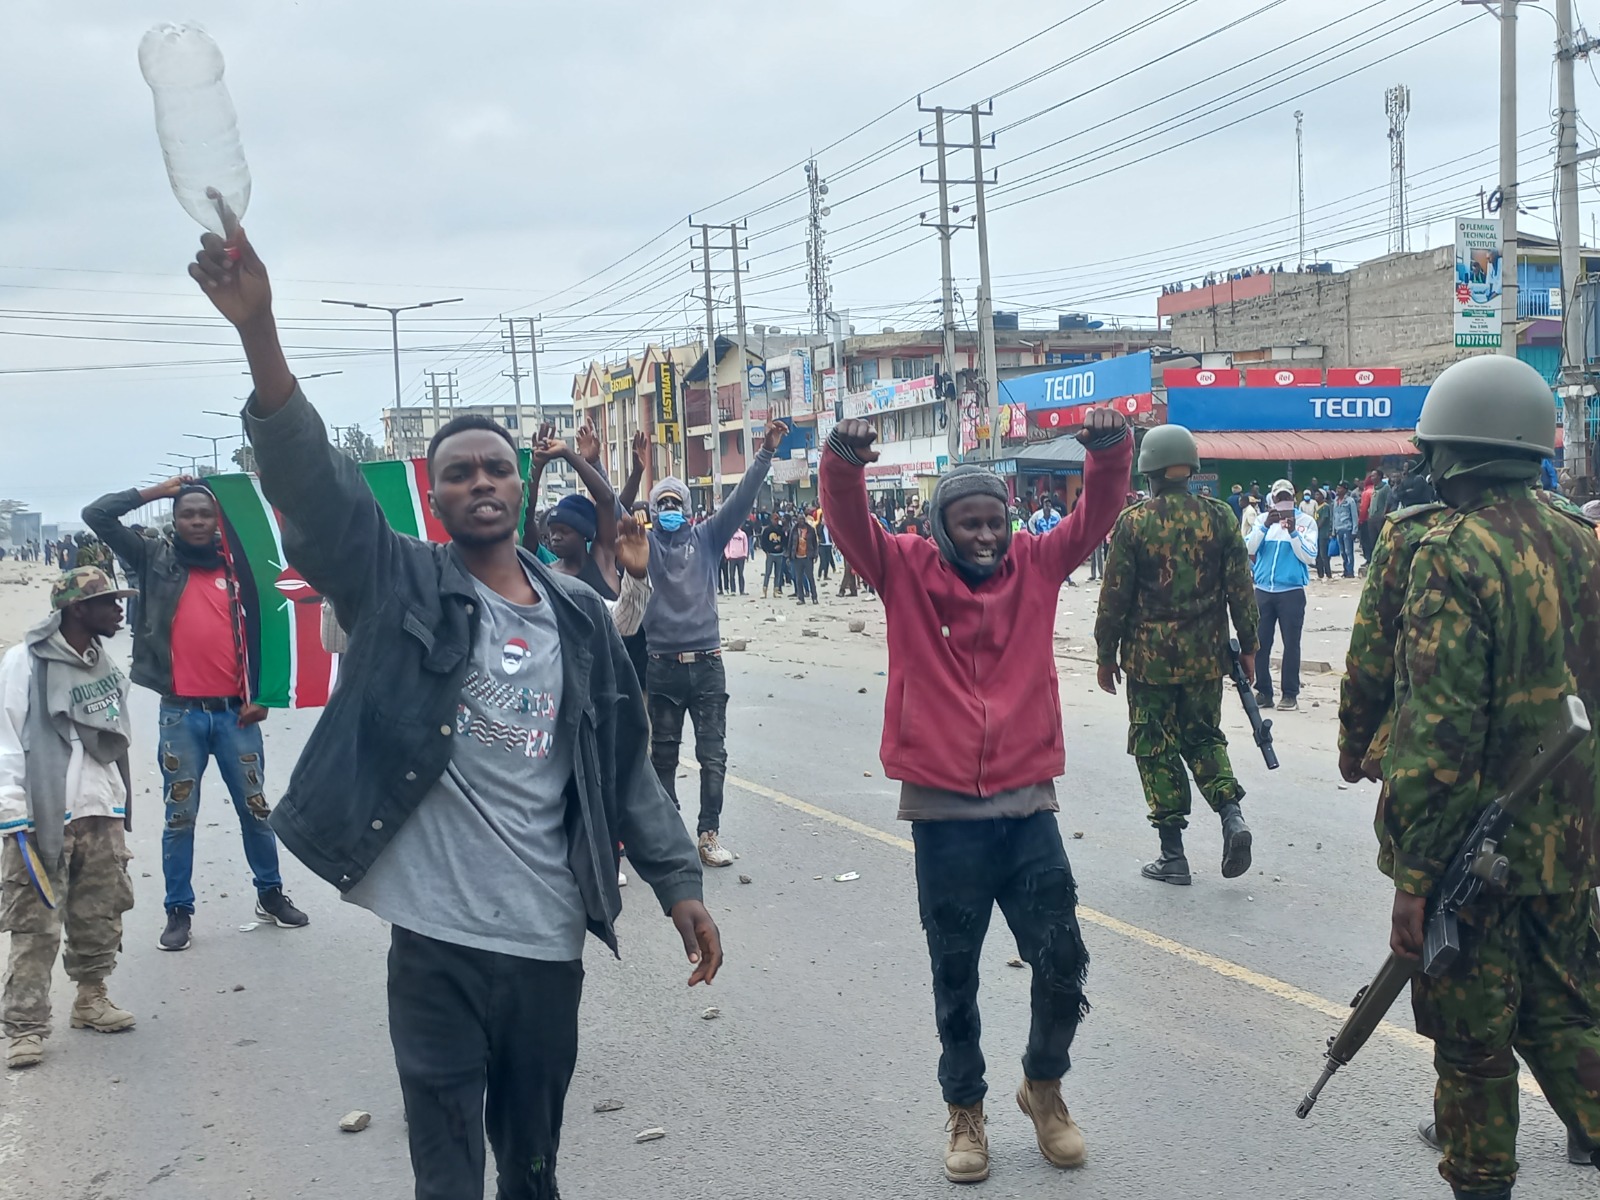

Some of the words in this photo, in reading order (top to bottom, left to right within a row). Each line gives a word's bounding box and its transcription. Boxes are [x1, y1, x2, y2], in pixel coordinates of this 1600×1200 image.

[1466, 223, 1494, 231] FLEMING
[1463, 232, 1498, 240] TECHNICAL
[1456, 335, 1501, 345] 0797731441
[1199, 373, 1213, 383] itel
[1278, 373, 1291, 382] itel
[1358, 373, 1371, 382] itel
[661, 363, 673, 420] EASTMATT
[1044, 371, 1095, 402] TECNO
[1309, 397, 1391, 418] TECNO
[1013, 421, 1027, 436] Food
